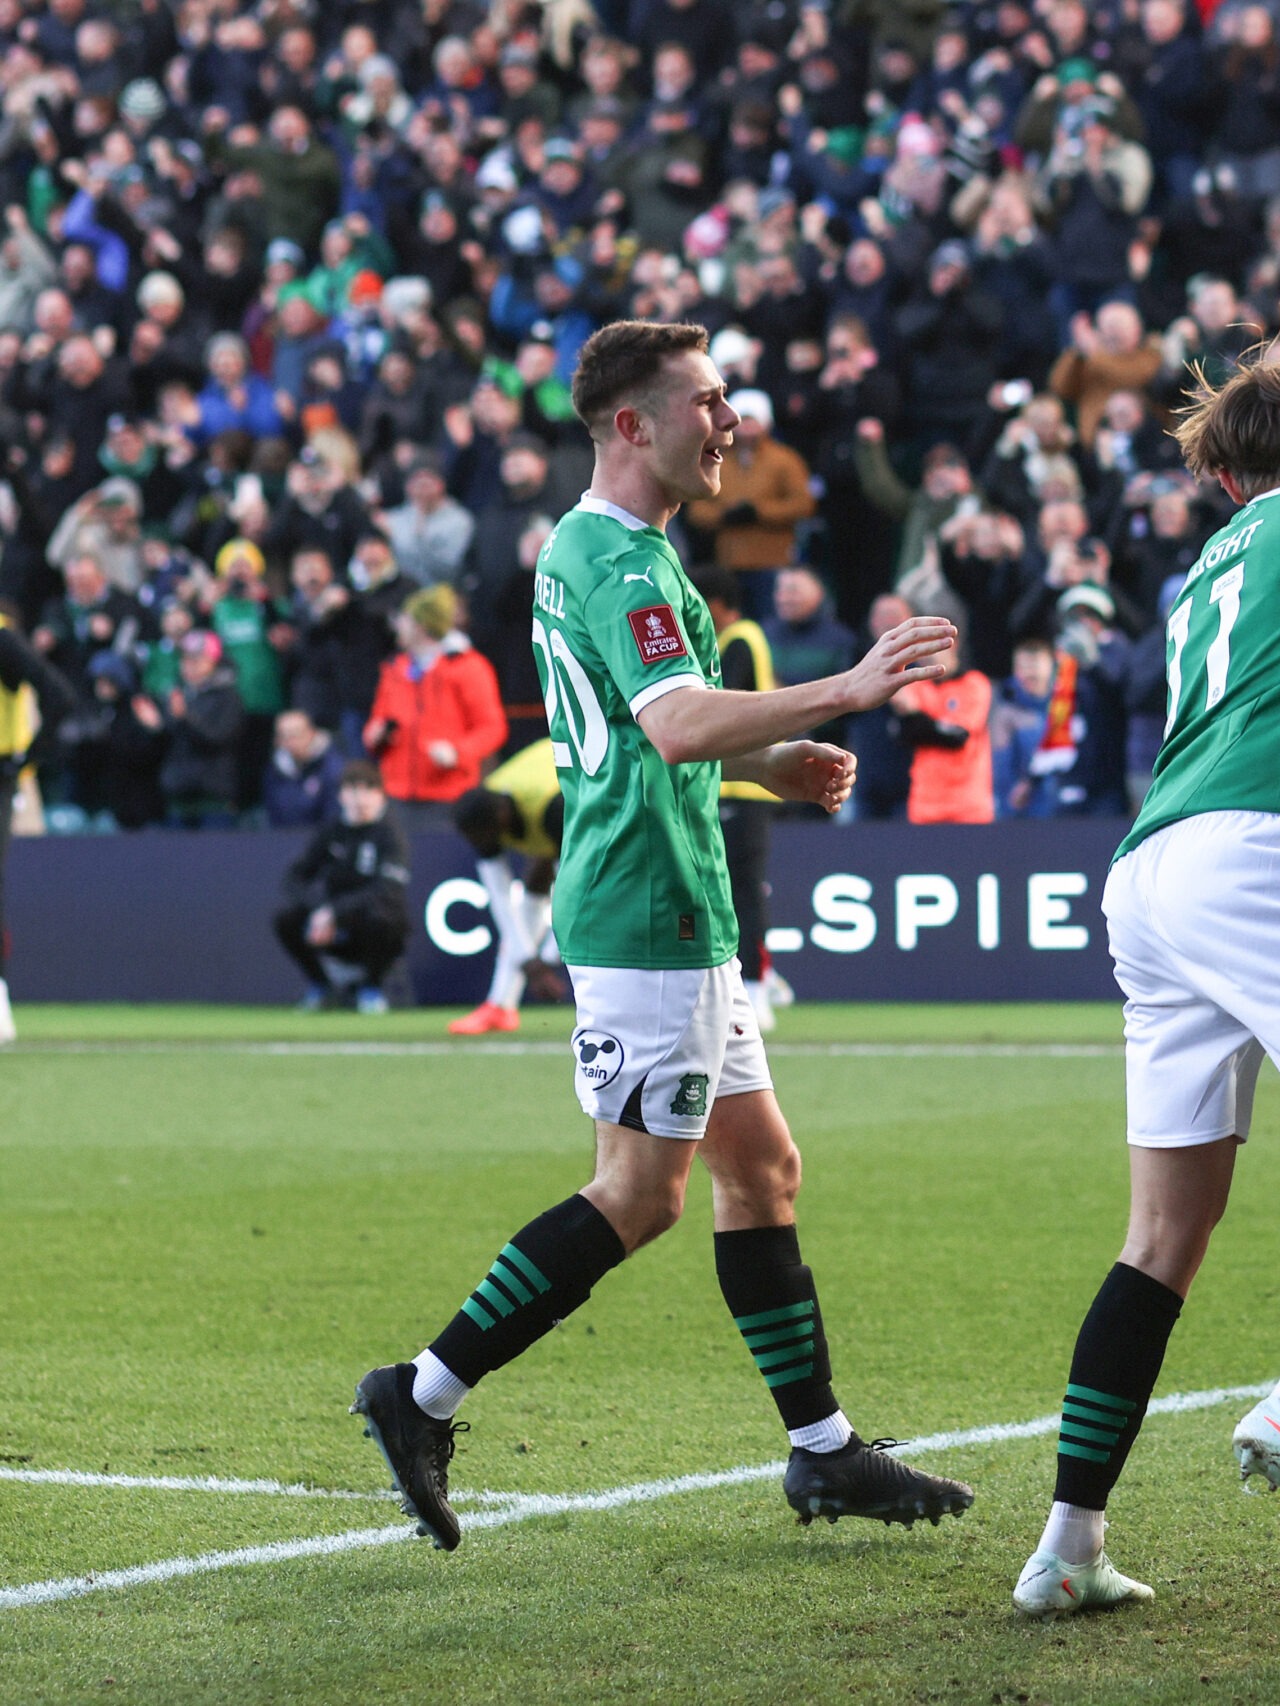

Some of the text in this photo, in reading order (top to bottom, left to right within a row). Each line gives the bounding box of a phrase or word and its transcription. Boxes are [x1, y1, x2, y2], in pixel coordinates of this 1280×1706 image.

[534, 572, 566, 619] DELL
[643, 636, 678, 649] Emirates
[646, 642, 680, 657] FA CUP
[1162, 560, 1245, 741] 11
[531, 617, 609, 776] 20
[581, 1065, 608, 1080] tain
